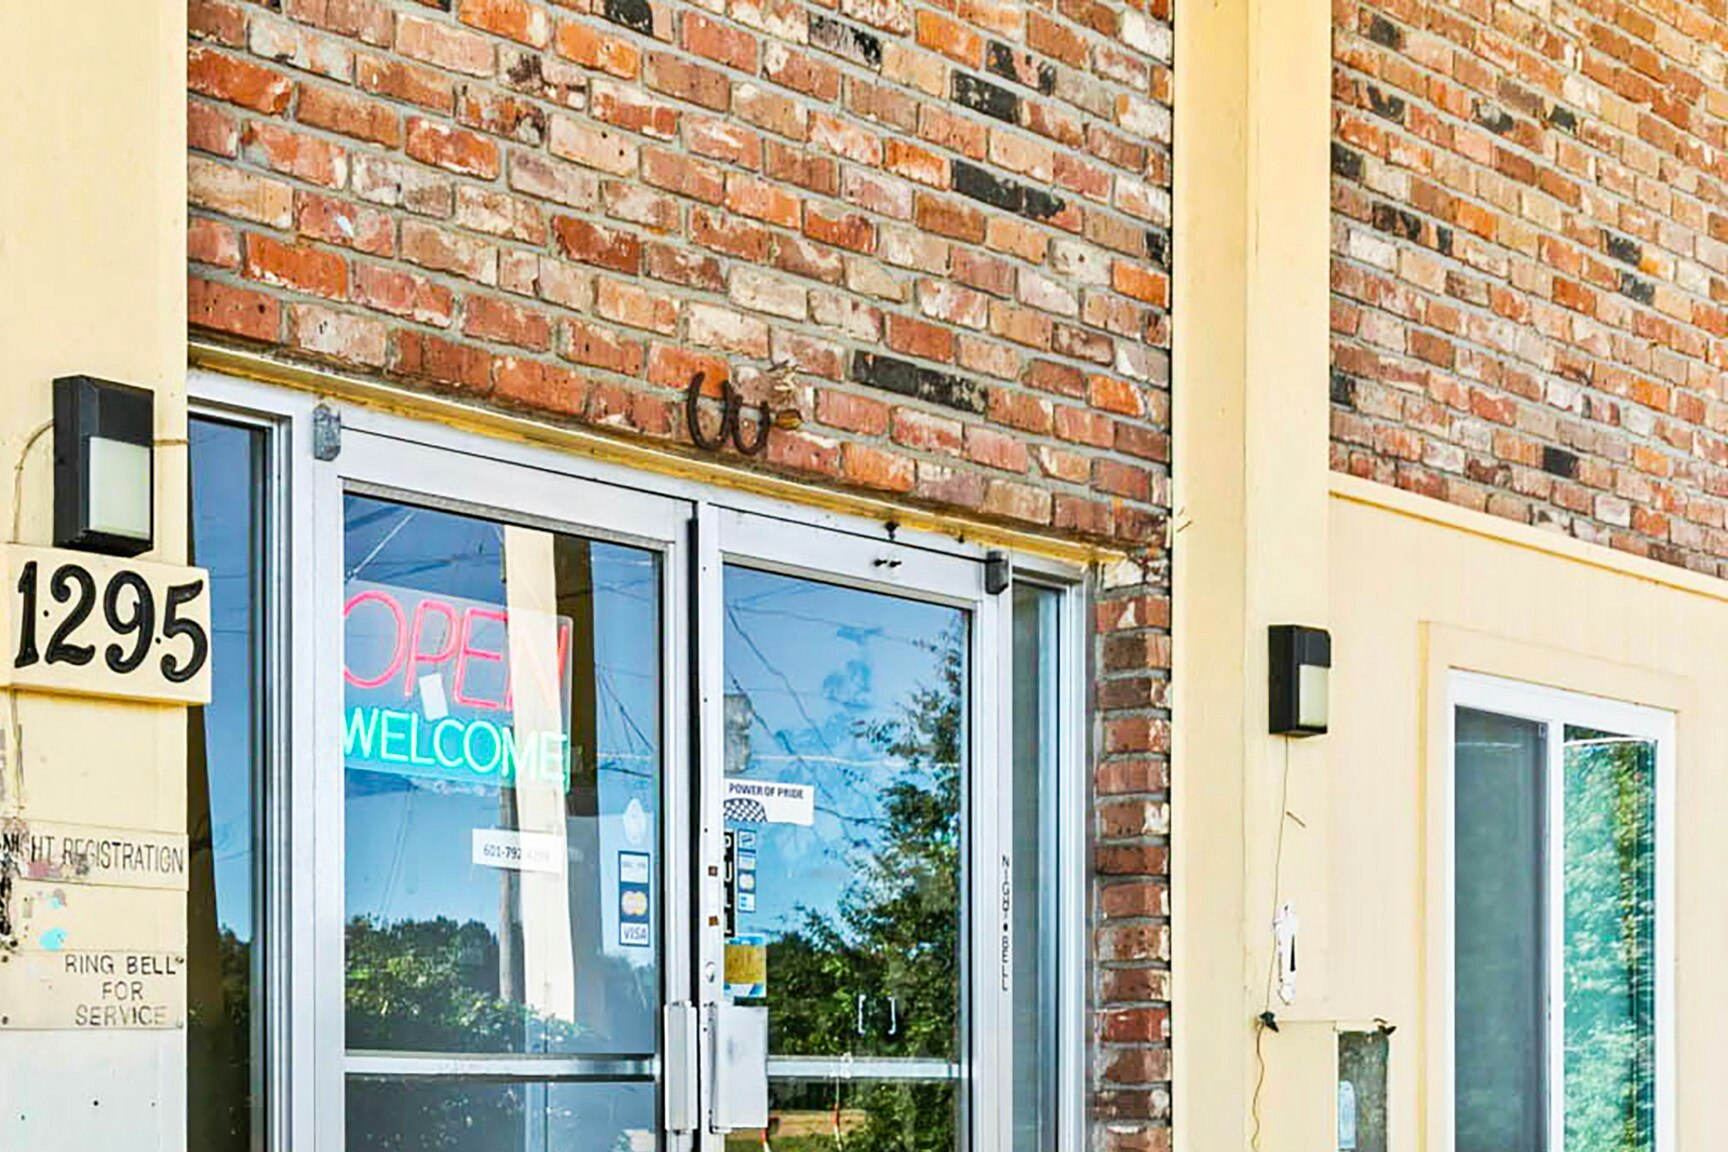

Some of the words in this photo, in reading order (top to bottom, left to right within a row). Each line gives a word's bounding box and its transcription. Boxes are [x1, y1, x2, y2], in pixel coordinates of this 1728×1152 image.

[14, 561, 208, 683] 1295
[344, 706, 568, 784] WELCOME
[729, 783, 763, 796] POWER
[764, 785, 775, 797] OF
[777, 787, 804, 799] PRIDE
[62, 836, 184, 875] REGISTRATION
[623, 925, 647, 940] VISA
[65, 954, 114, 975] RING
[126, 956, 177, 976] BELL
[101, 981, 144, 1001] FOR
[75, 1004, 167, 1027] SERVICE
